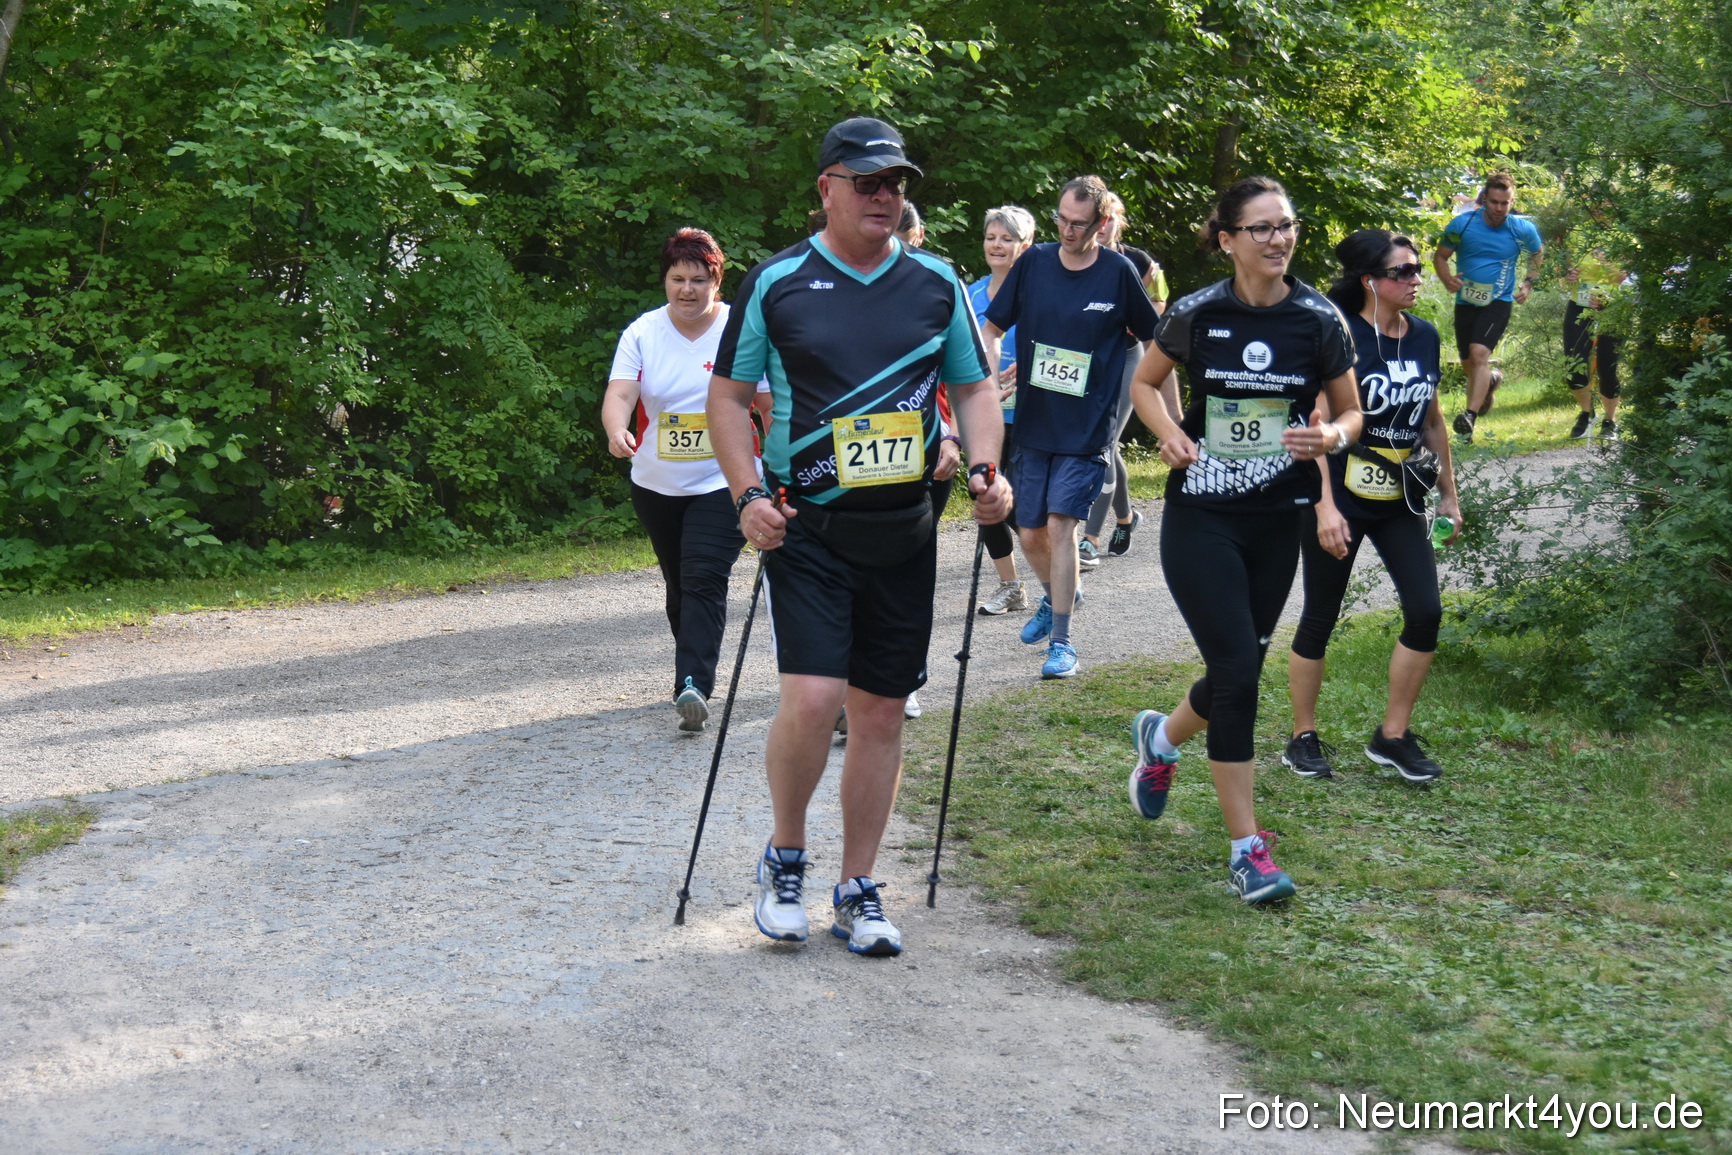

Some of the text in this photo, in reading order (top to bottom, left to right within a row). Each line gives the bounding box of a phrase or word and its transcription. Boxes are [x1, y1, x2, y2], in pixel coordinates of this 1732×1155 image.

[1465, 288, 1488, 300] 1726
[1207, 328, 1230, 338] JAKO
[1039, 360, 1079, 383] 1454
[896, 365, 939, 412] Donauer
[1225, 381, 1284, 392] SCHOTTERWERKE
[669, 430, 703, 447] 357
[1230, 420, 1261, 442] 98
[847, 437, 913, 467] 2177
[858, 464, 888, 474] Donauer
